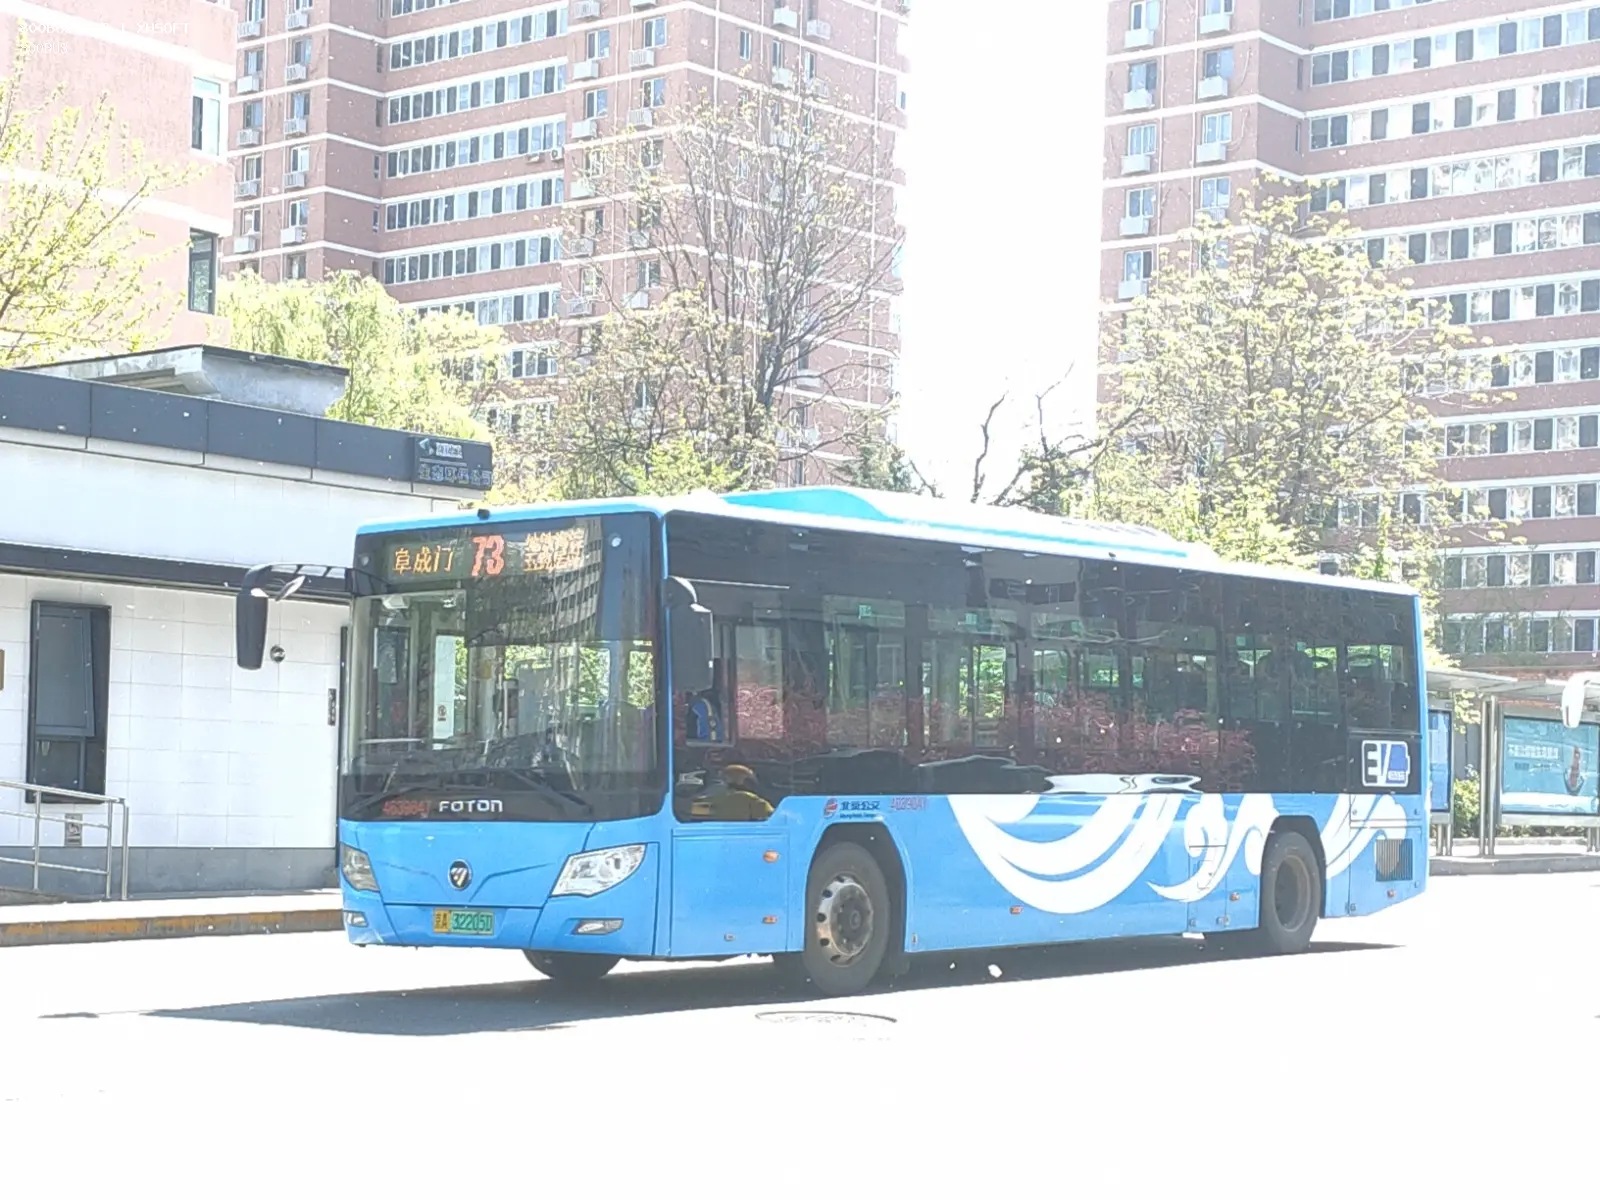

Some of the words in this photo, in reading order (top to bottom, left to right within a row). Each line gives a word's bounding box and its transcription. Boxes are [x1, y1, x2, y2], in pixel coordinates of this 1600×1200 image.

[392, 545, 454, 574] 阜成门
[471, 535, 505, 576] 73
[439, 800, 503, 812] FOTON
[840, 801, 880, 811] 北京公交
